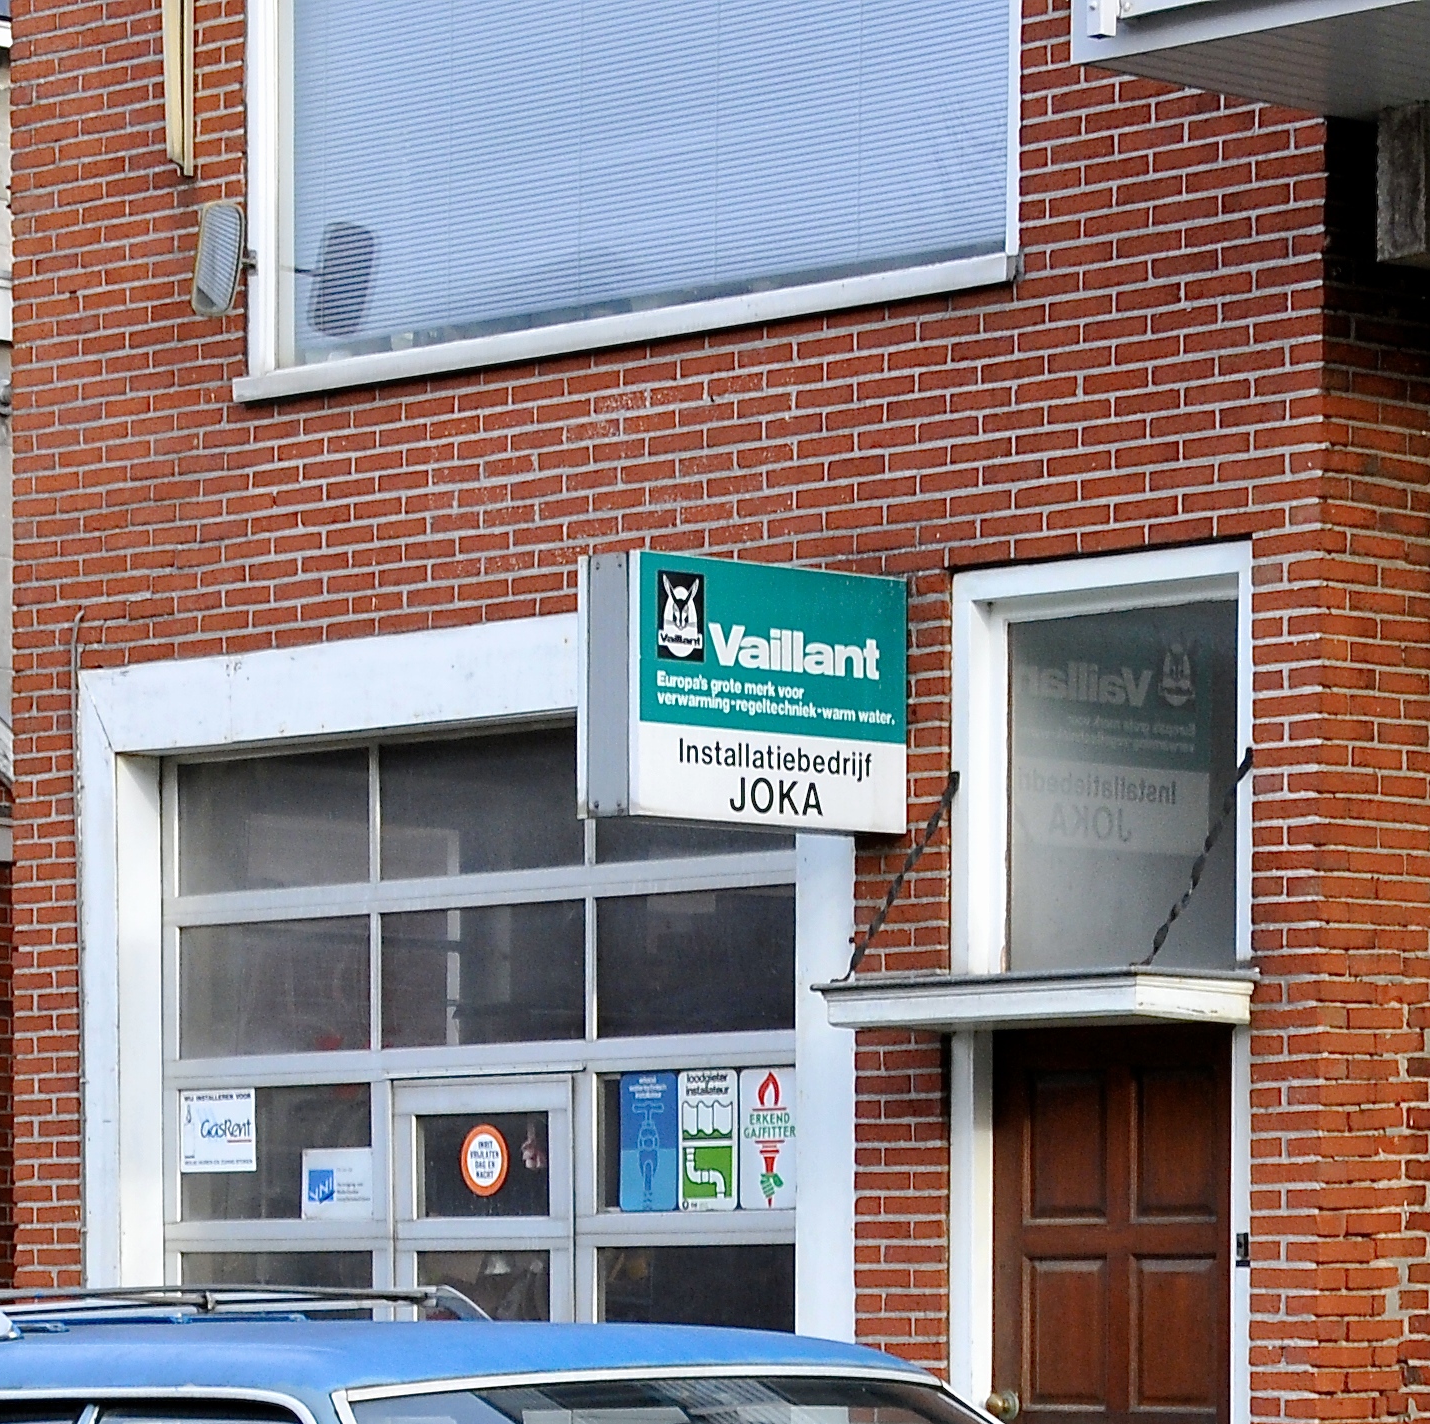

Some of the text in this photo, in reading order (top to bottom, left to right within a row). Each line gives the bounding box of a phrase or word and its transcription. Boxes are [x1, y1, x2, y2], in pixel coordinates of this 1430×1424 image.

[660, 632, 701, 647] Vaillant
[708, 622, 880, 680] Vaillant
[656, 670, 805, 700] Europa's grote merk voor
[678, 738, 873, 783] Installatiebedrijf
[729, 777, 824, 817] JOKA
[743, 1125, 797, 1139] GASFITTER
[749, 1112, 790, 1125] ERKEND
